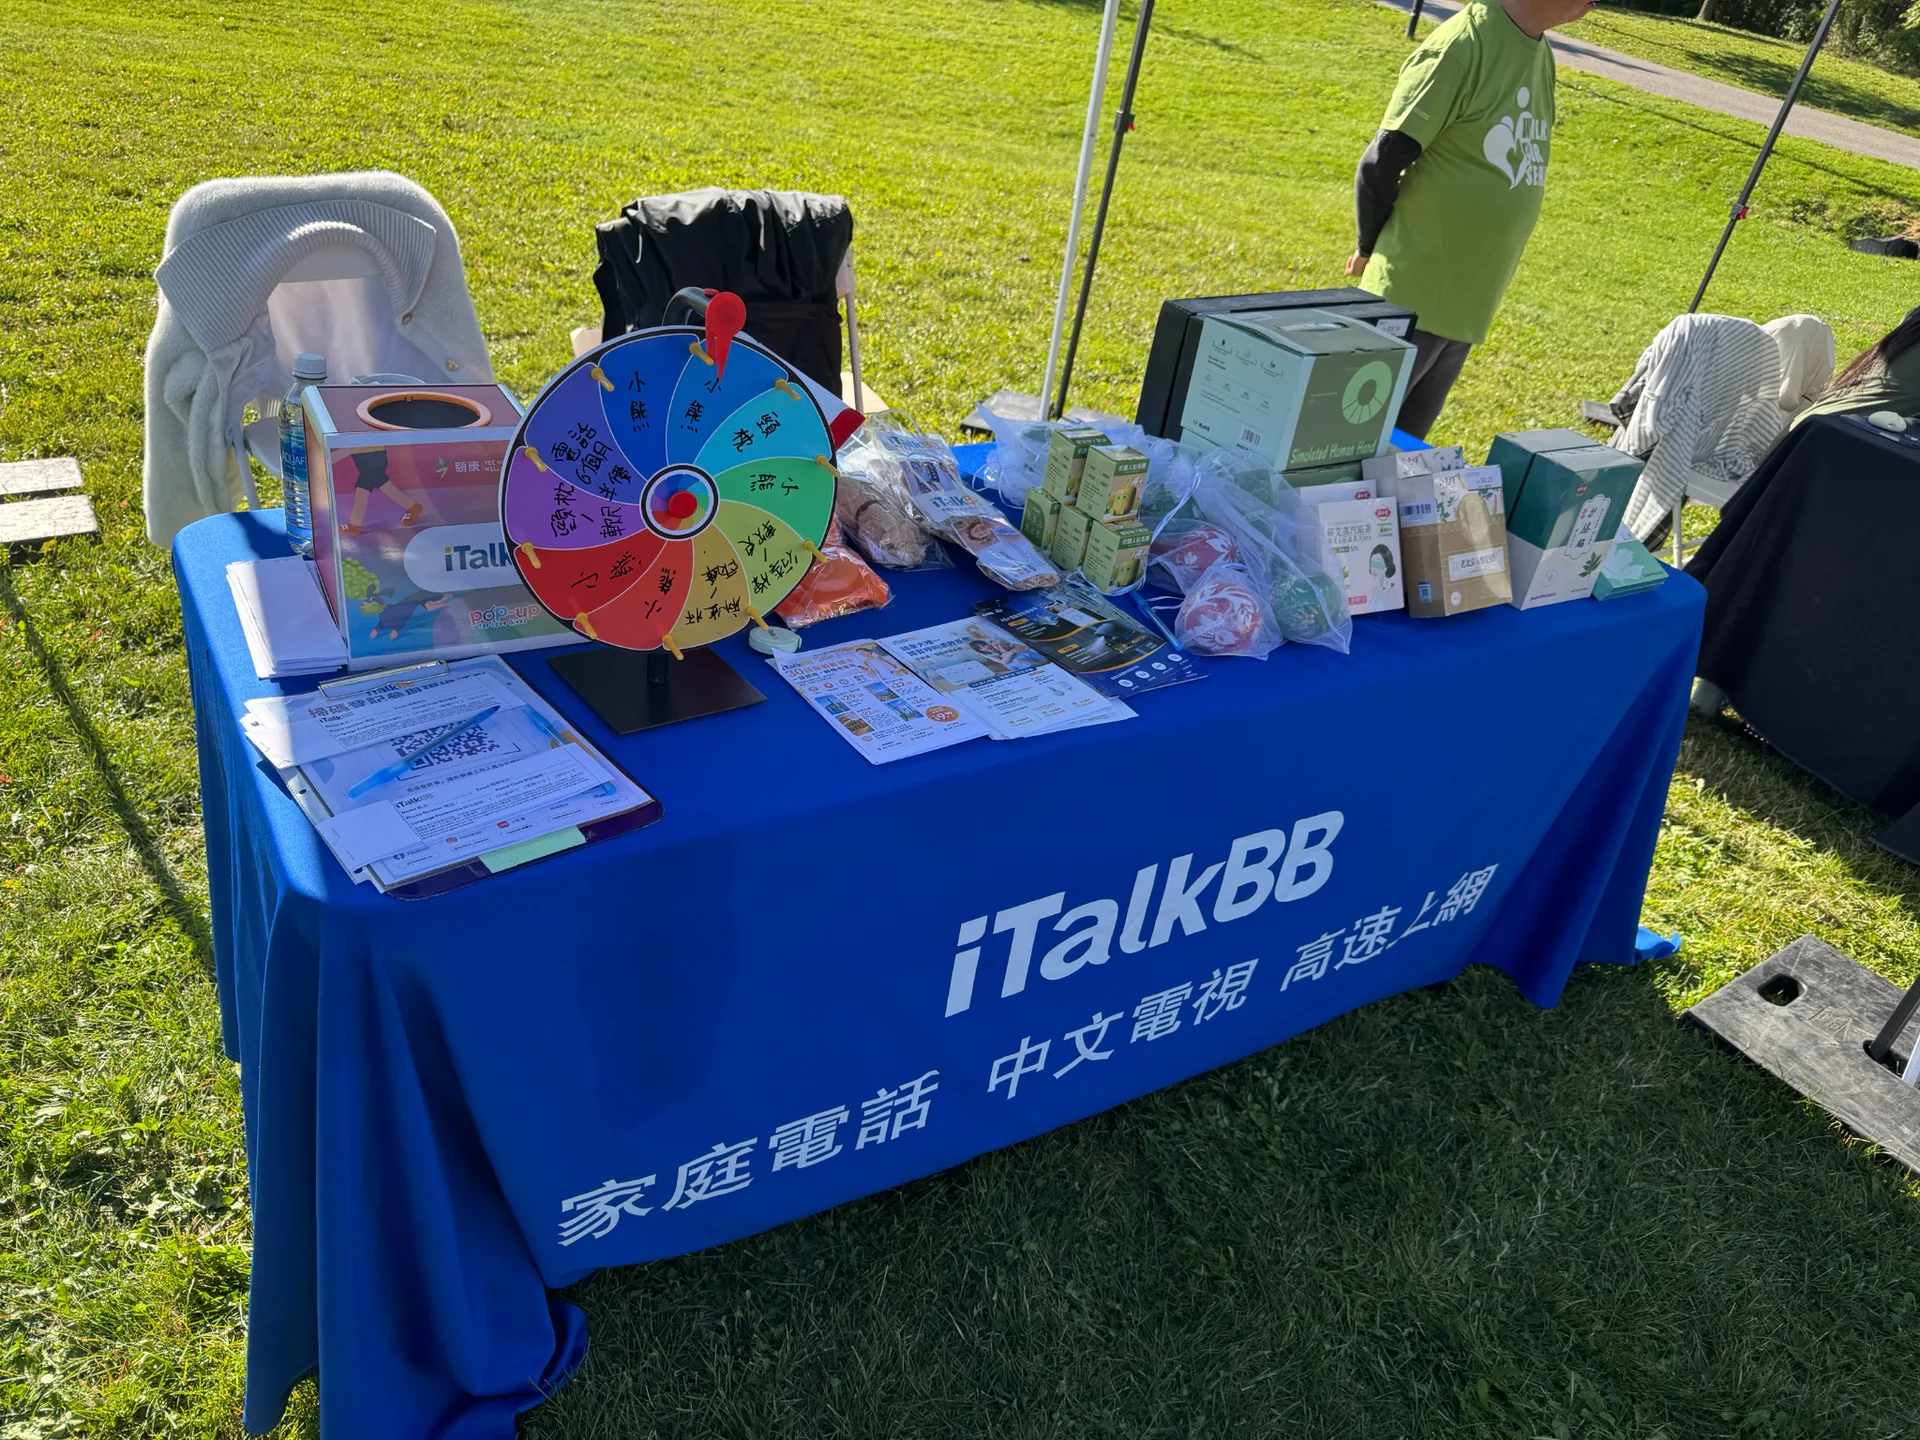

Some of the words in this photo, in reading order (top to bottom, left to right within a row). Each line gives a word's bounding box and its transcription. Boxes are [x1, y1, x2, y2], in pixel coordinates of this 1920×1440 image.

[1525, 164, 1547, 187] SEN
[629, 371, 650, 433] 小熊
[681, 376, 722, 434] 小熊
[551, 422, 597, 462] 電話
[575, 440, 613, 485] 6個月
[599, 464, 632, 502] 半價
[749, 473, 800, 497] 小熊
[444, 541, 512, 572] iTalk
[571, 550, 642, 589] 小熊
[645, 566, 677, 620] 小熊
[469, 605, 540, 626] pop-up
[943, 811, 1346, 1018] iTalkBB
[557, 1069, 941, 1248] 家庭電話
[986, 957, 1259, 1101] 中文電視
[1280, 863, 1499, 993] 高速上網
